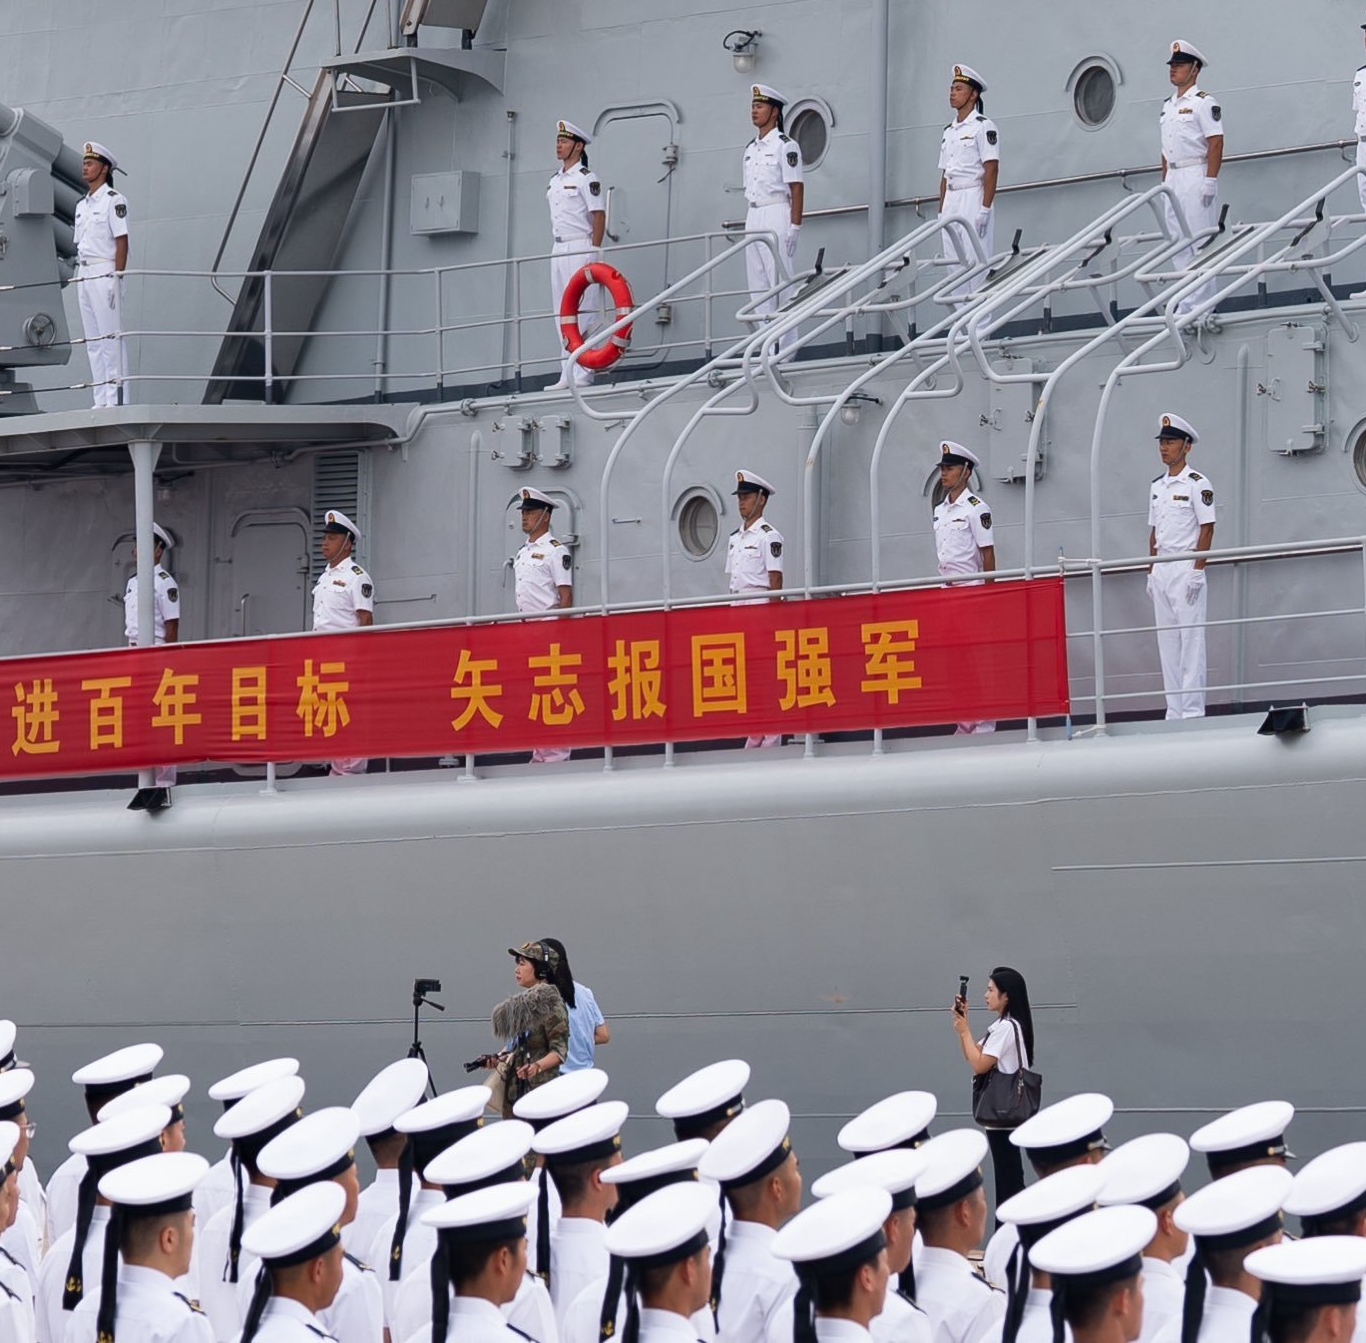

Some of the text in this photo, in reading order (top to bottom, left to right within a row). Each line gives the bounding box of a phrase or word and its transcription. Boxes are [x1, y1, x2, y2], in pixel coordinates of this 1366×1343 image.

[450, 618, 923, 732] 矢志报国强军
